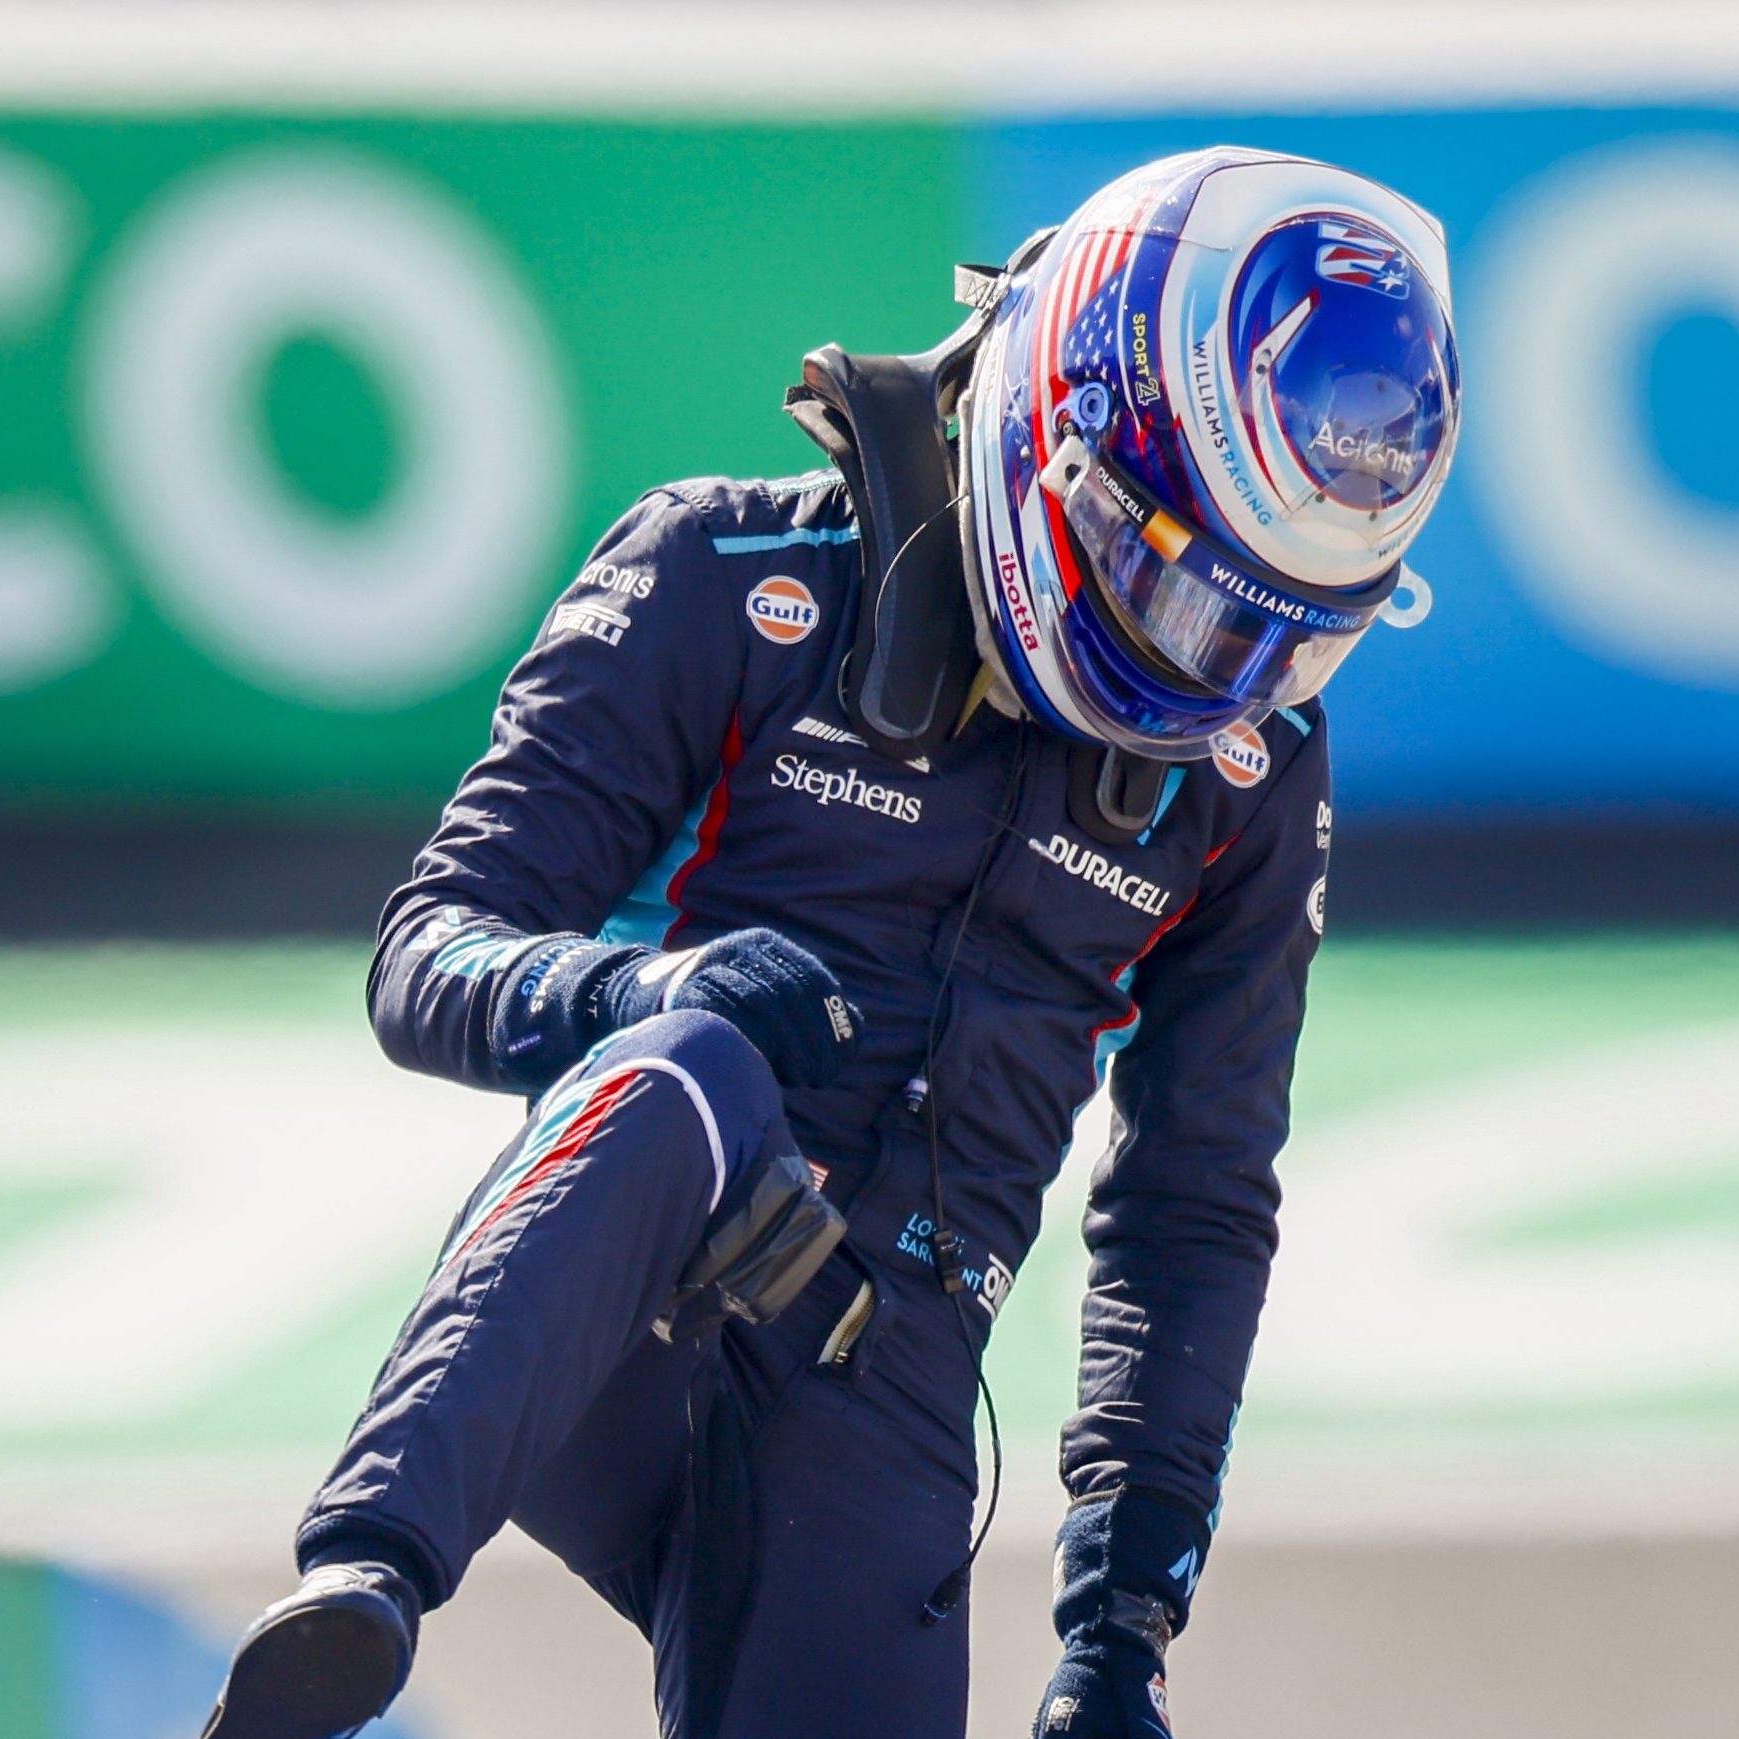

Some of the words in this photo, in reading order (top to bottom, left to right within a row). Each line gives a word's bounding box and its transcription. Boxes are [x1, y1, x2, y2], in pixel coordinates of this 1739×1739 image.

[1132, 313, 1150, 376] SPORT
[1193, 341, 1230, 449] WILLIAMS
[1220, 450, 1273, 526] RACING
[1096, 466, 1146, 523] DURACELL
[577, 560, 655, 600] cronis
[751, 597, 814, 624] Gulf
[999, 552, 1040, 651] ibotta
[1210, 563, 1306, 622] WILLIAMS
[1303, 608, 1362, 630] RACING
[1213, 731, 1266, 773] Gulf
[771, 754, 922, 824] Stephens
[1048, 834, 1171, 917] DURACELL
[828, 995, 855, 1040] OMP
